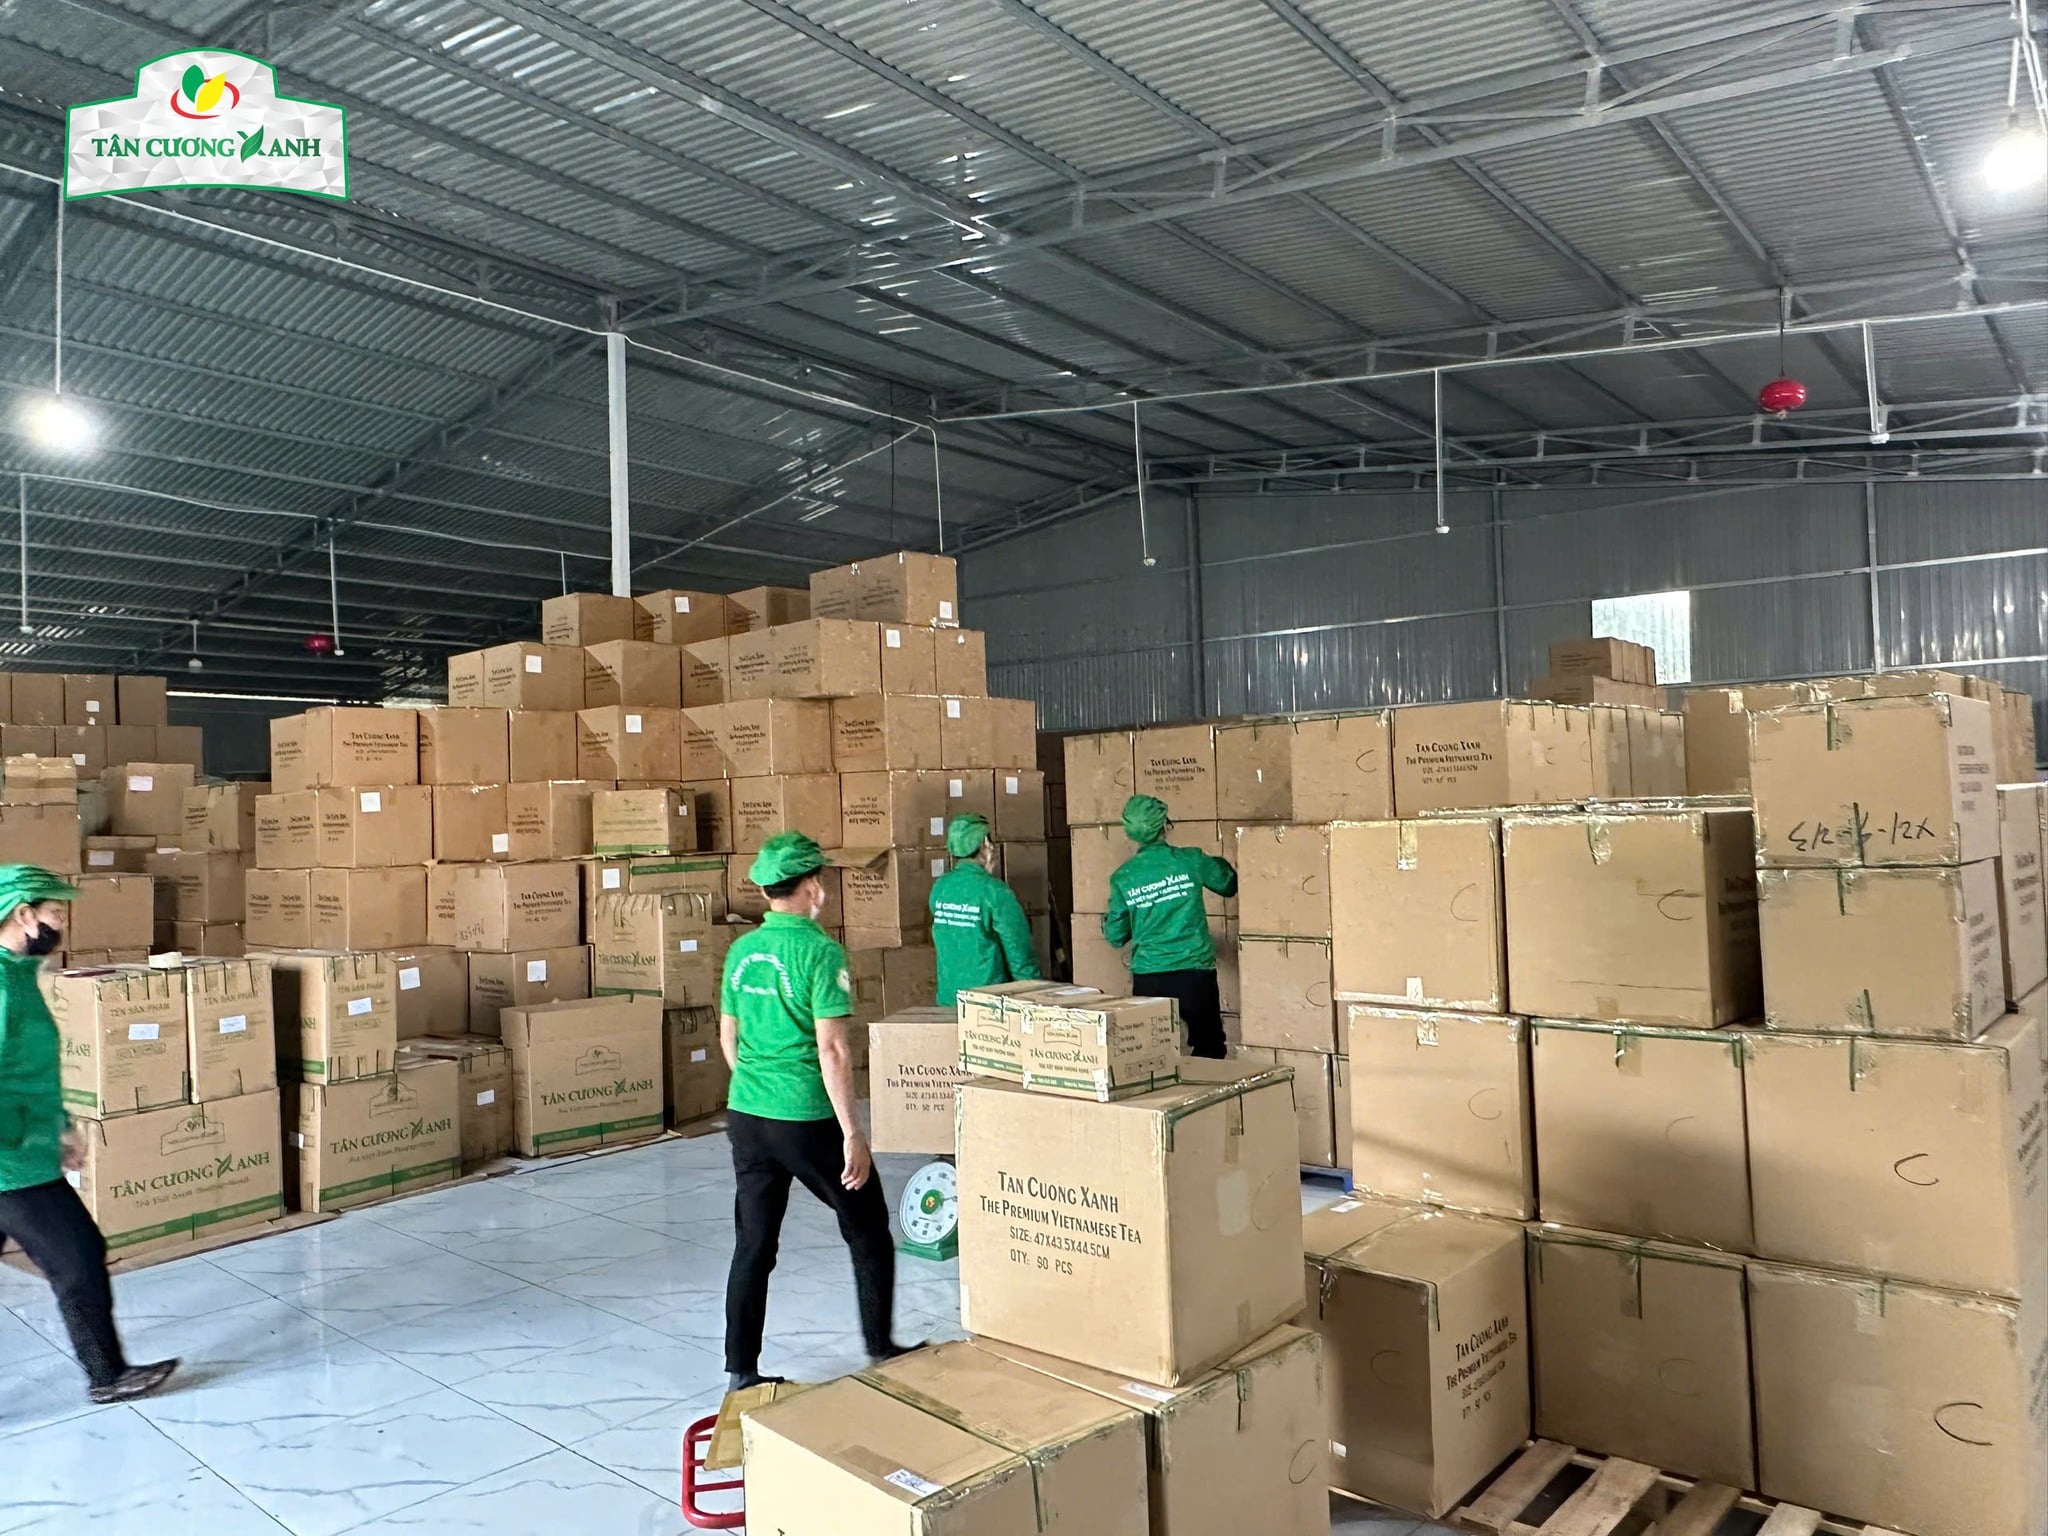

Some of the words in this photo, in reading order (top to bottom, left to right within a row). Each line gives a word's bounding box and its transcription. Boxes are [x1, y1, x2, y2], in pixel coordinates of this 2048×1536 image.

[898, 1064, 915, 1076] TAN
[916, 1064, 948, 1076] CUONG
[110, 1178, 147, 1199] TÂN
[998, 1171, 1024, 1195] TAN
[1027, 1176, 1077, 1205] CUONG
[1080, 1186, 1119, 1214] XANH
[980, 1195, 1000, 1214] THE
[1002, 1200, 1049, 1225] PREMIUM
[1051, 1209, 1117, 1239] VIETNAMESE
[1119, 1223, 1142, 1245] TEA
[1009, 1226, 1032, 1243] SIZE:
[1010, 1249, 1030, 1265] QTY:
[1055, 1259, 1073, 1275] PCS
